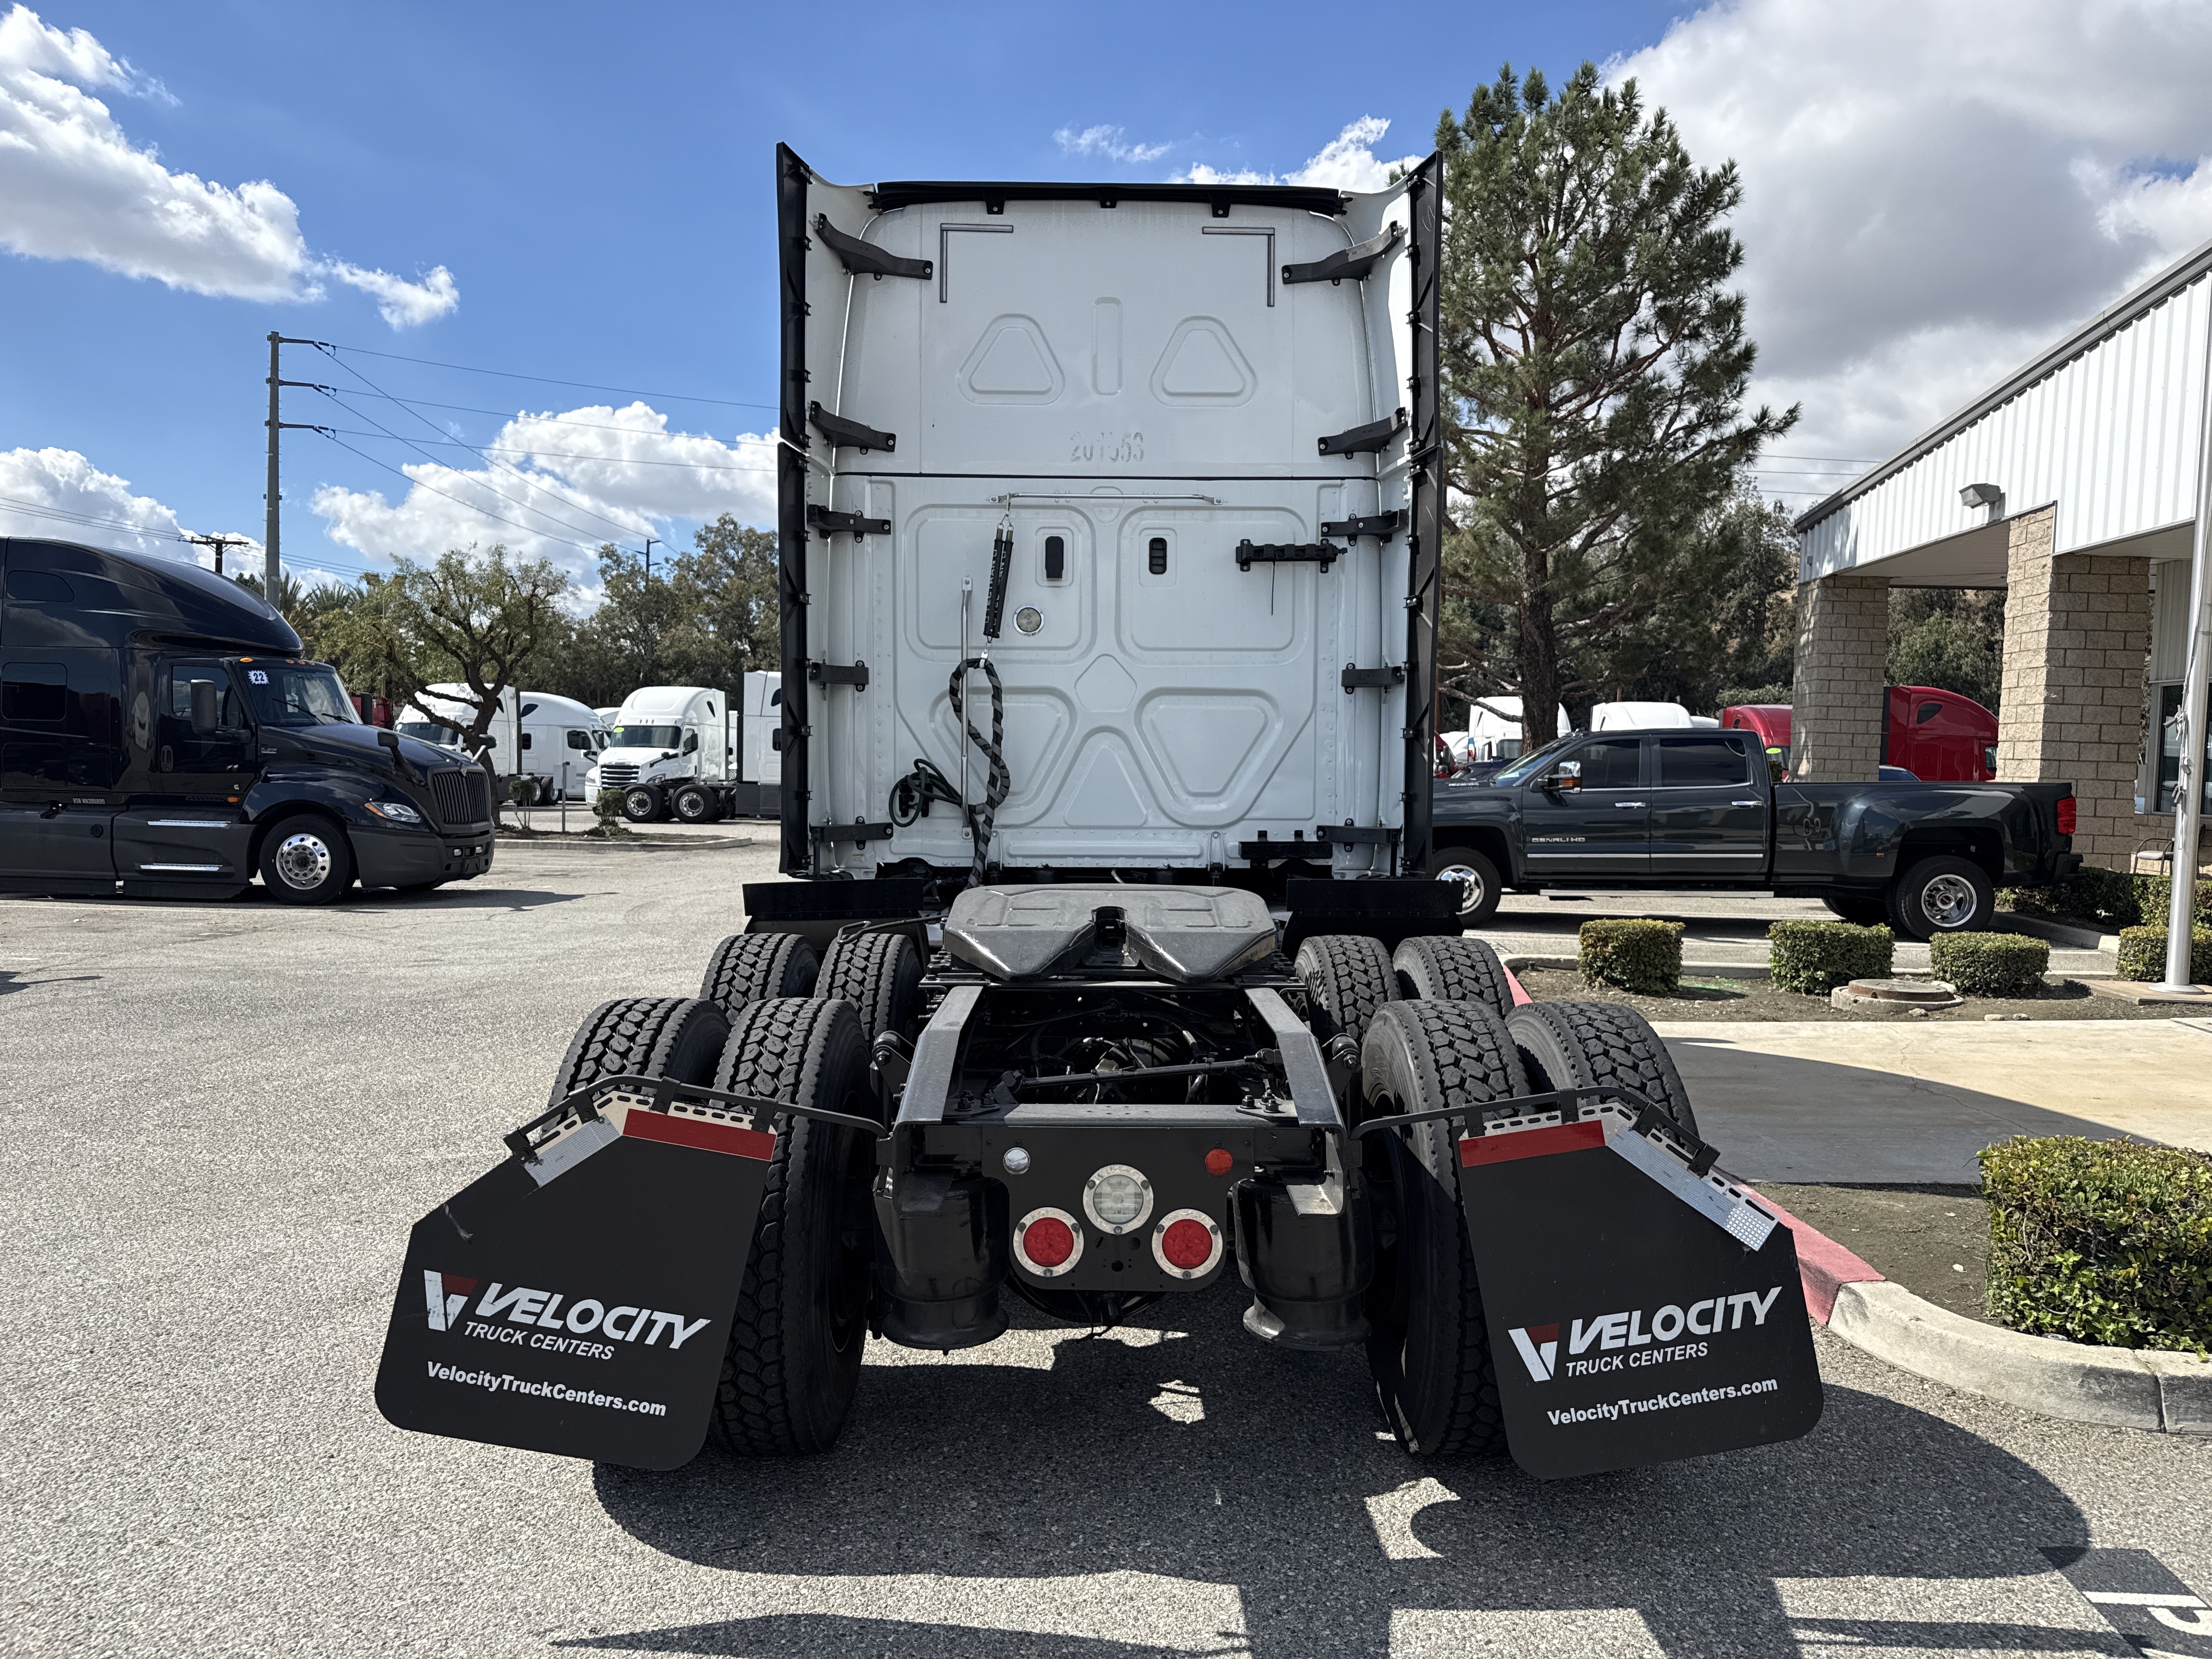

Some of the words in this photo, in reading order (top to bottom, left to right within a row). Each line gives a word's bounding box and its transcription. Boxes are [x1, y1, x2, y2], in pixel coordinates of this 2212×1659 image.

[253, 673, 265, 681] 22
[475, 1282, 712, 1349] VELOCITY
[1569, 1286, 1783, 1355] VELOCITY
[464, 1321, 529, 1345] TRUCK
[530, 1333, 615, 1359] CENTERS
[1566, 1355, 1624, 1377] TRUCK
[1629, 1342, 1708, 1368] CENTERS
[427, 1361, 667, 1417] VelocityTruckCenters.com
[1547, 1379, 1778, 1425] VelocityTruckCenters.com
